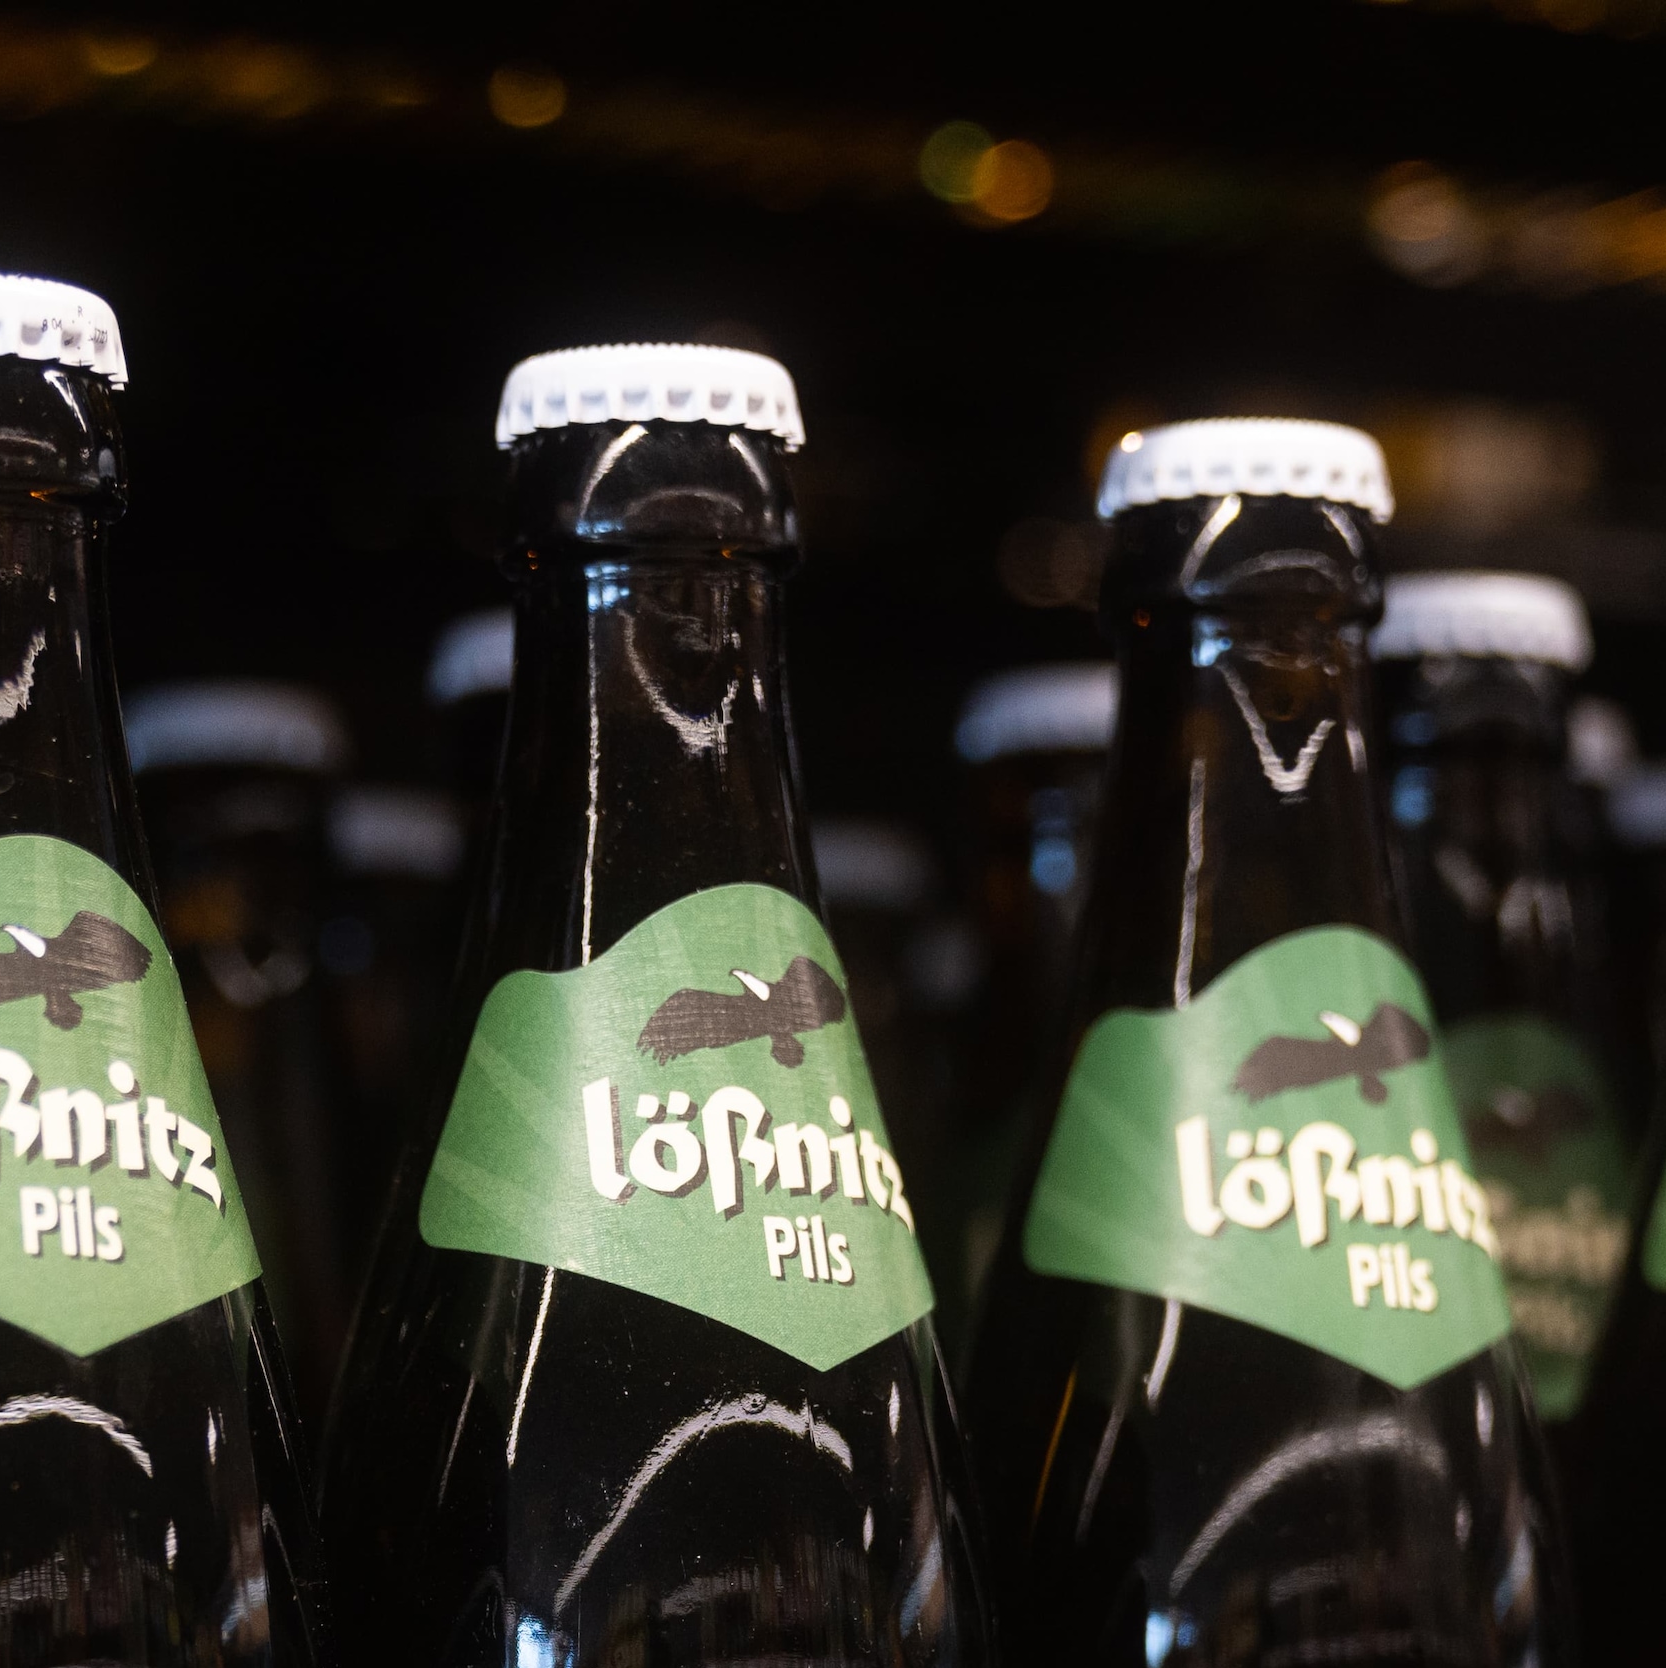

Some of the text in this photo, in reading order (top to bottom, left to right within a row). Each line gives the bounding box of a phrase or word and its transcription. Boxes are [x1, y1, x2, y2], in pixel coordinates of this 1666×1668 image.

[581, 1076, 916, 1237] lößnitz
[20, 1185, 123, 1262] Pils
[763, 1215, 855, 1287] Pils
[1346, 1243, 1438, 1313] Pils
